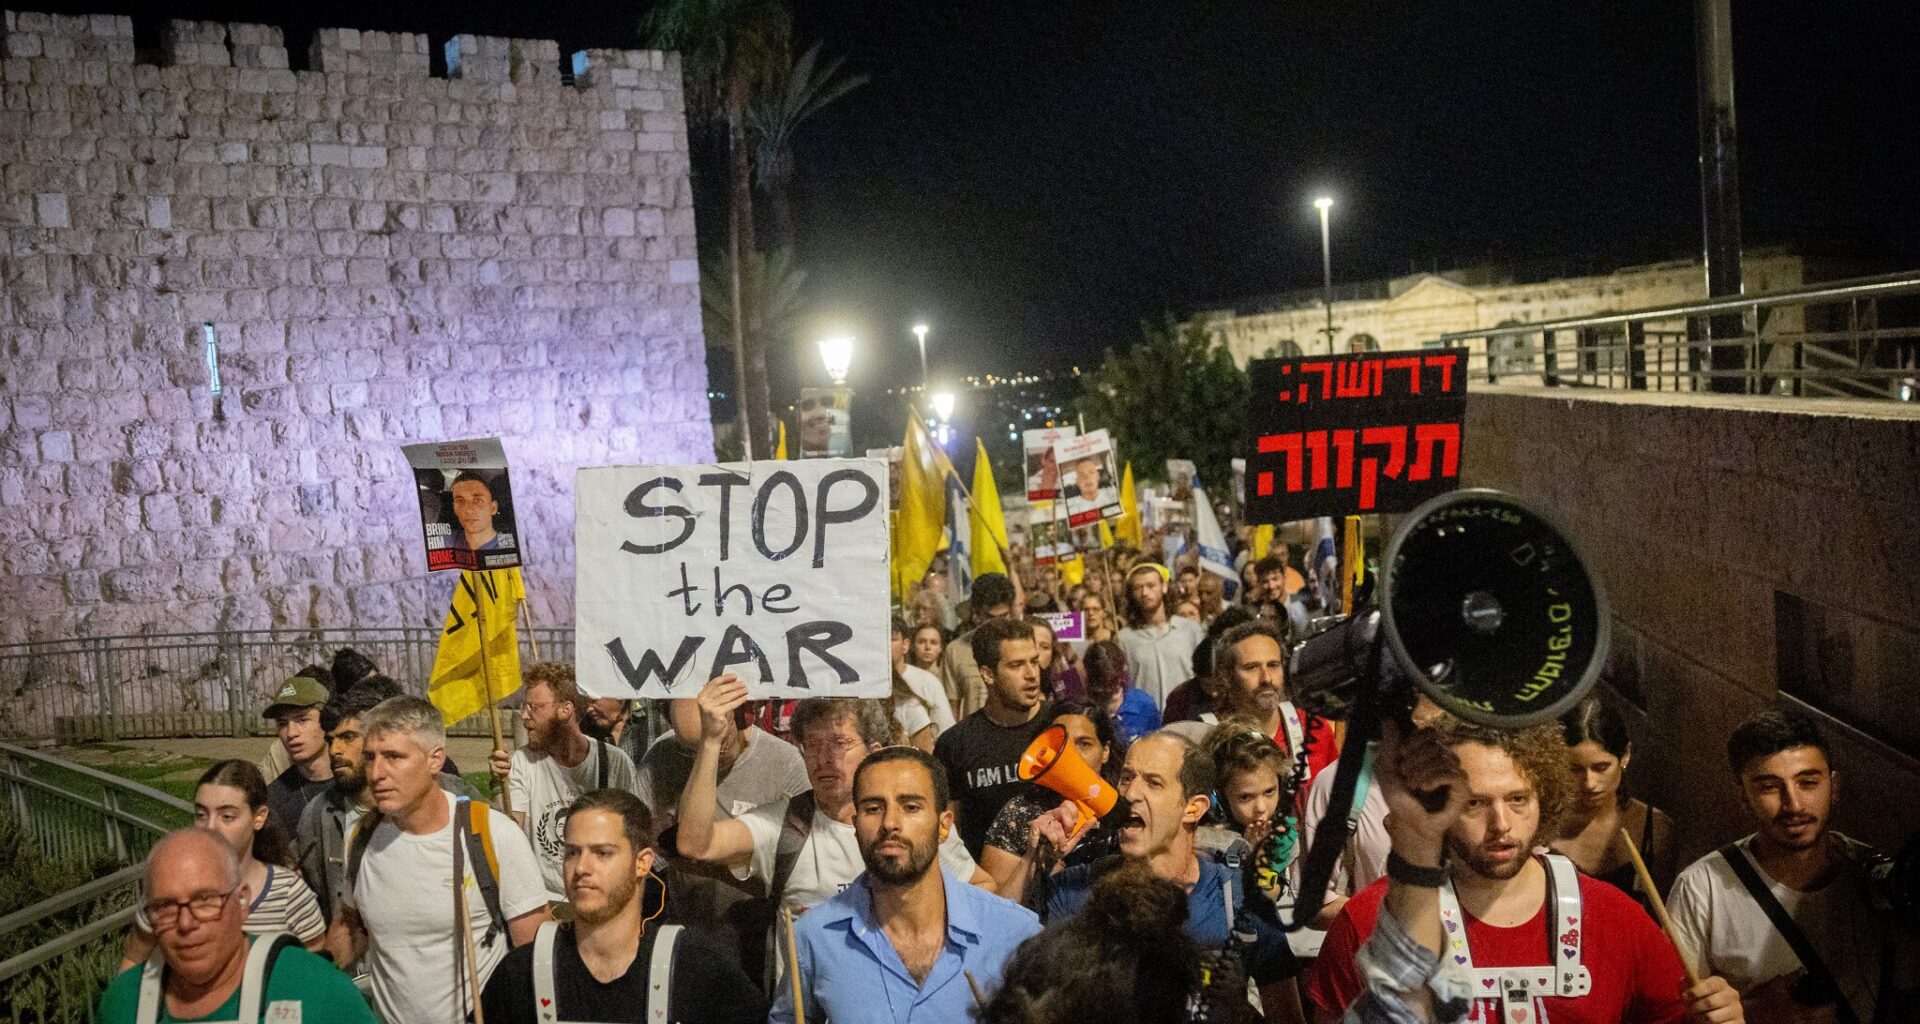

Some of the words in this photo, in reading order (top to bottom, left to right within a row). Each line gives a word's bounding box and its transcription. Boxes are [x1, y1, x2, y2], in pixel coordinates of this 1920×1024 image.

[1280, 355, 1457, 403] דרושה:
[1257, 423, 1460, 510] תקווה
[425, 522, 452, 536] BRING
[619, 468, 880, 568] STOP
[427, 535, 445, 550] HIM
[429, 549, 454, 564] HOME
[665, 562, 800, 617] the
[604, 620, 861, 693] WAR
[967, 771, 973, 788] I
[977, 766, 1001, 788] AM
